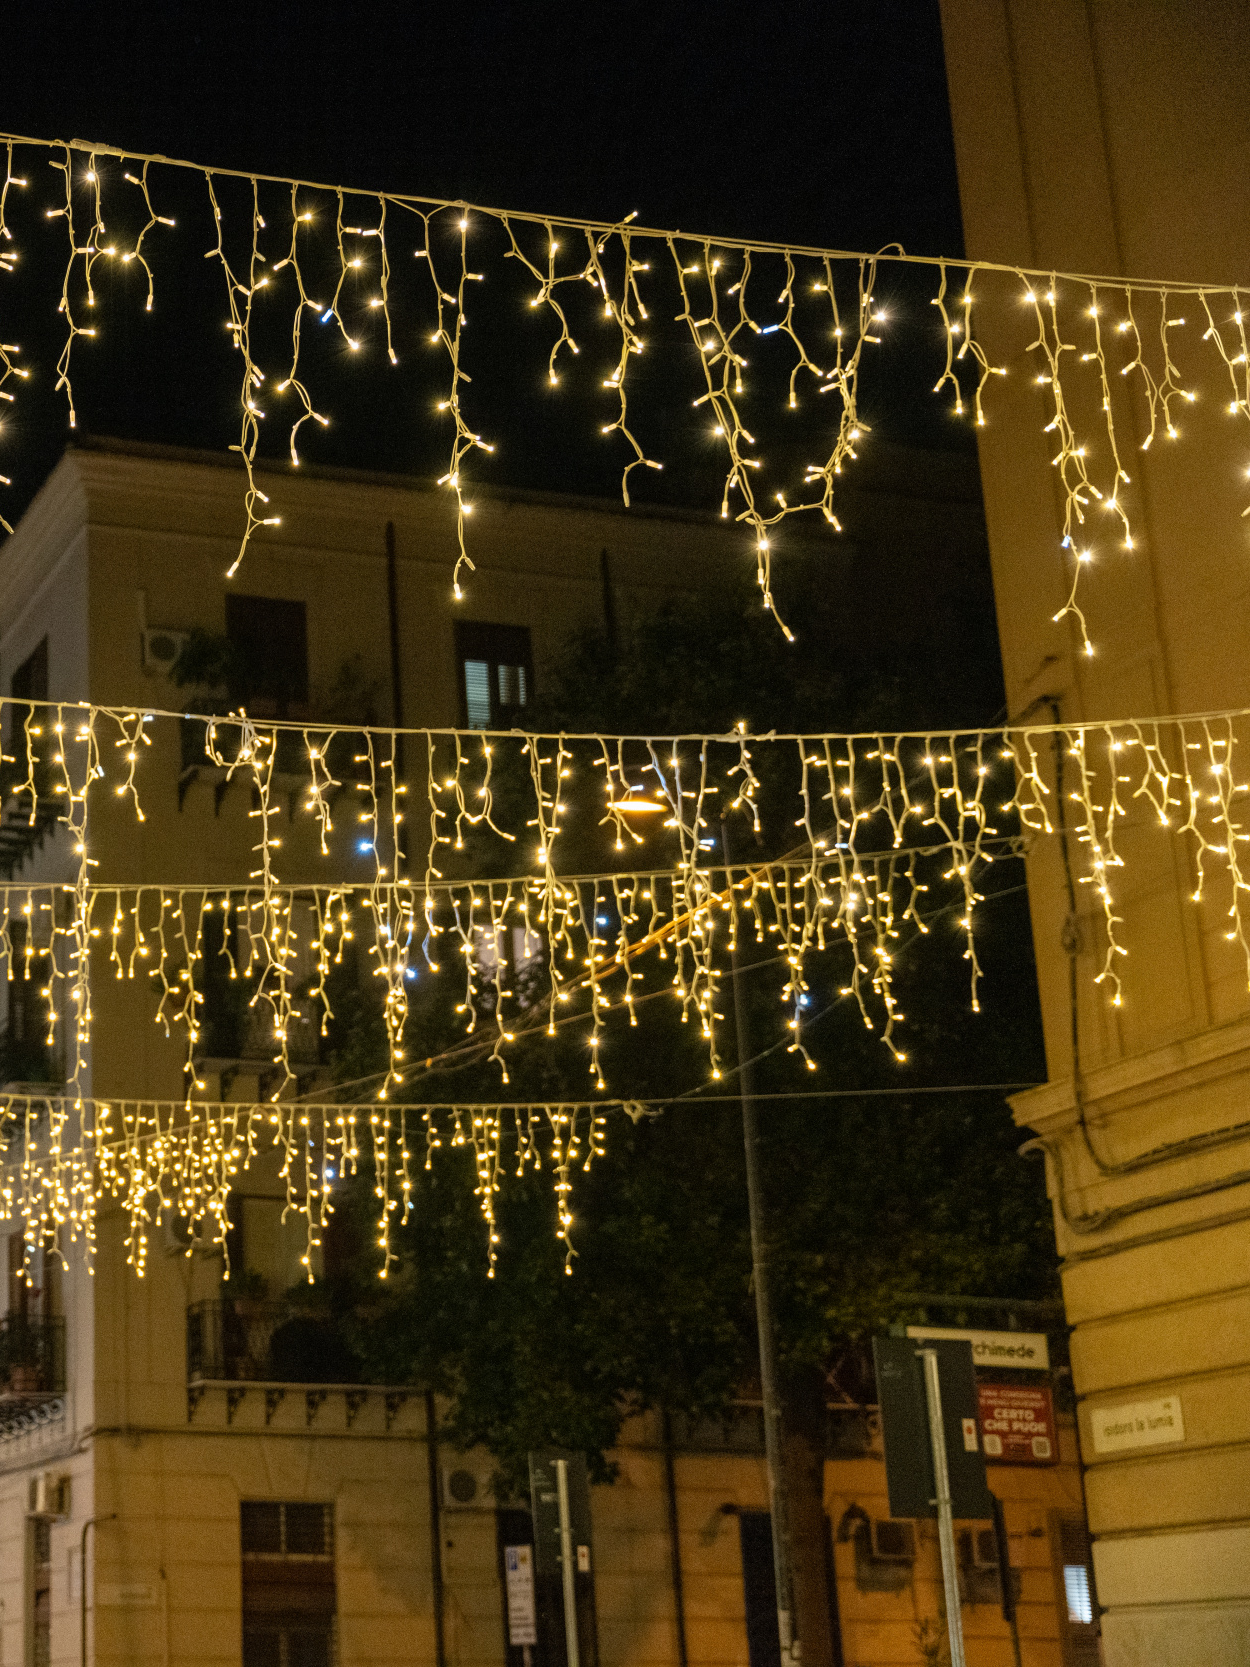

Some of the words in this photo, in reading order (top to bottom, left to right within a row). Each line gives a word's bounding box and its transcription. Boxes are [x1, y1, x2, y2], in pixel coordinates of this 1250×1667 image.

[973, 1341, 1035, 1358] chimede
[993, 1407, 1035, 1421] CERTO
[984, 1418, 1010, 1431] CHE
